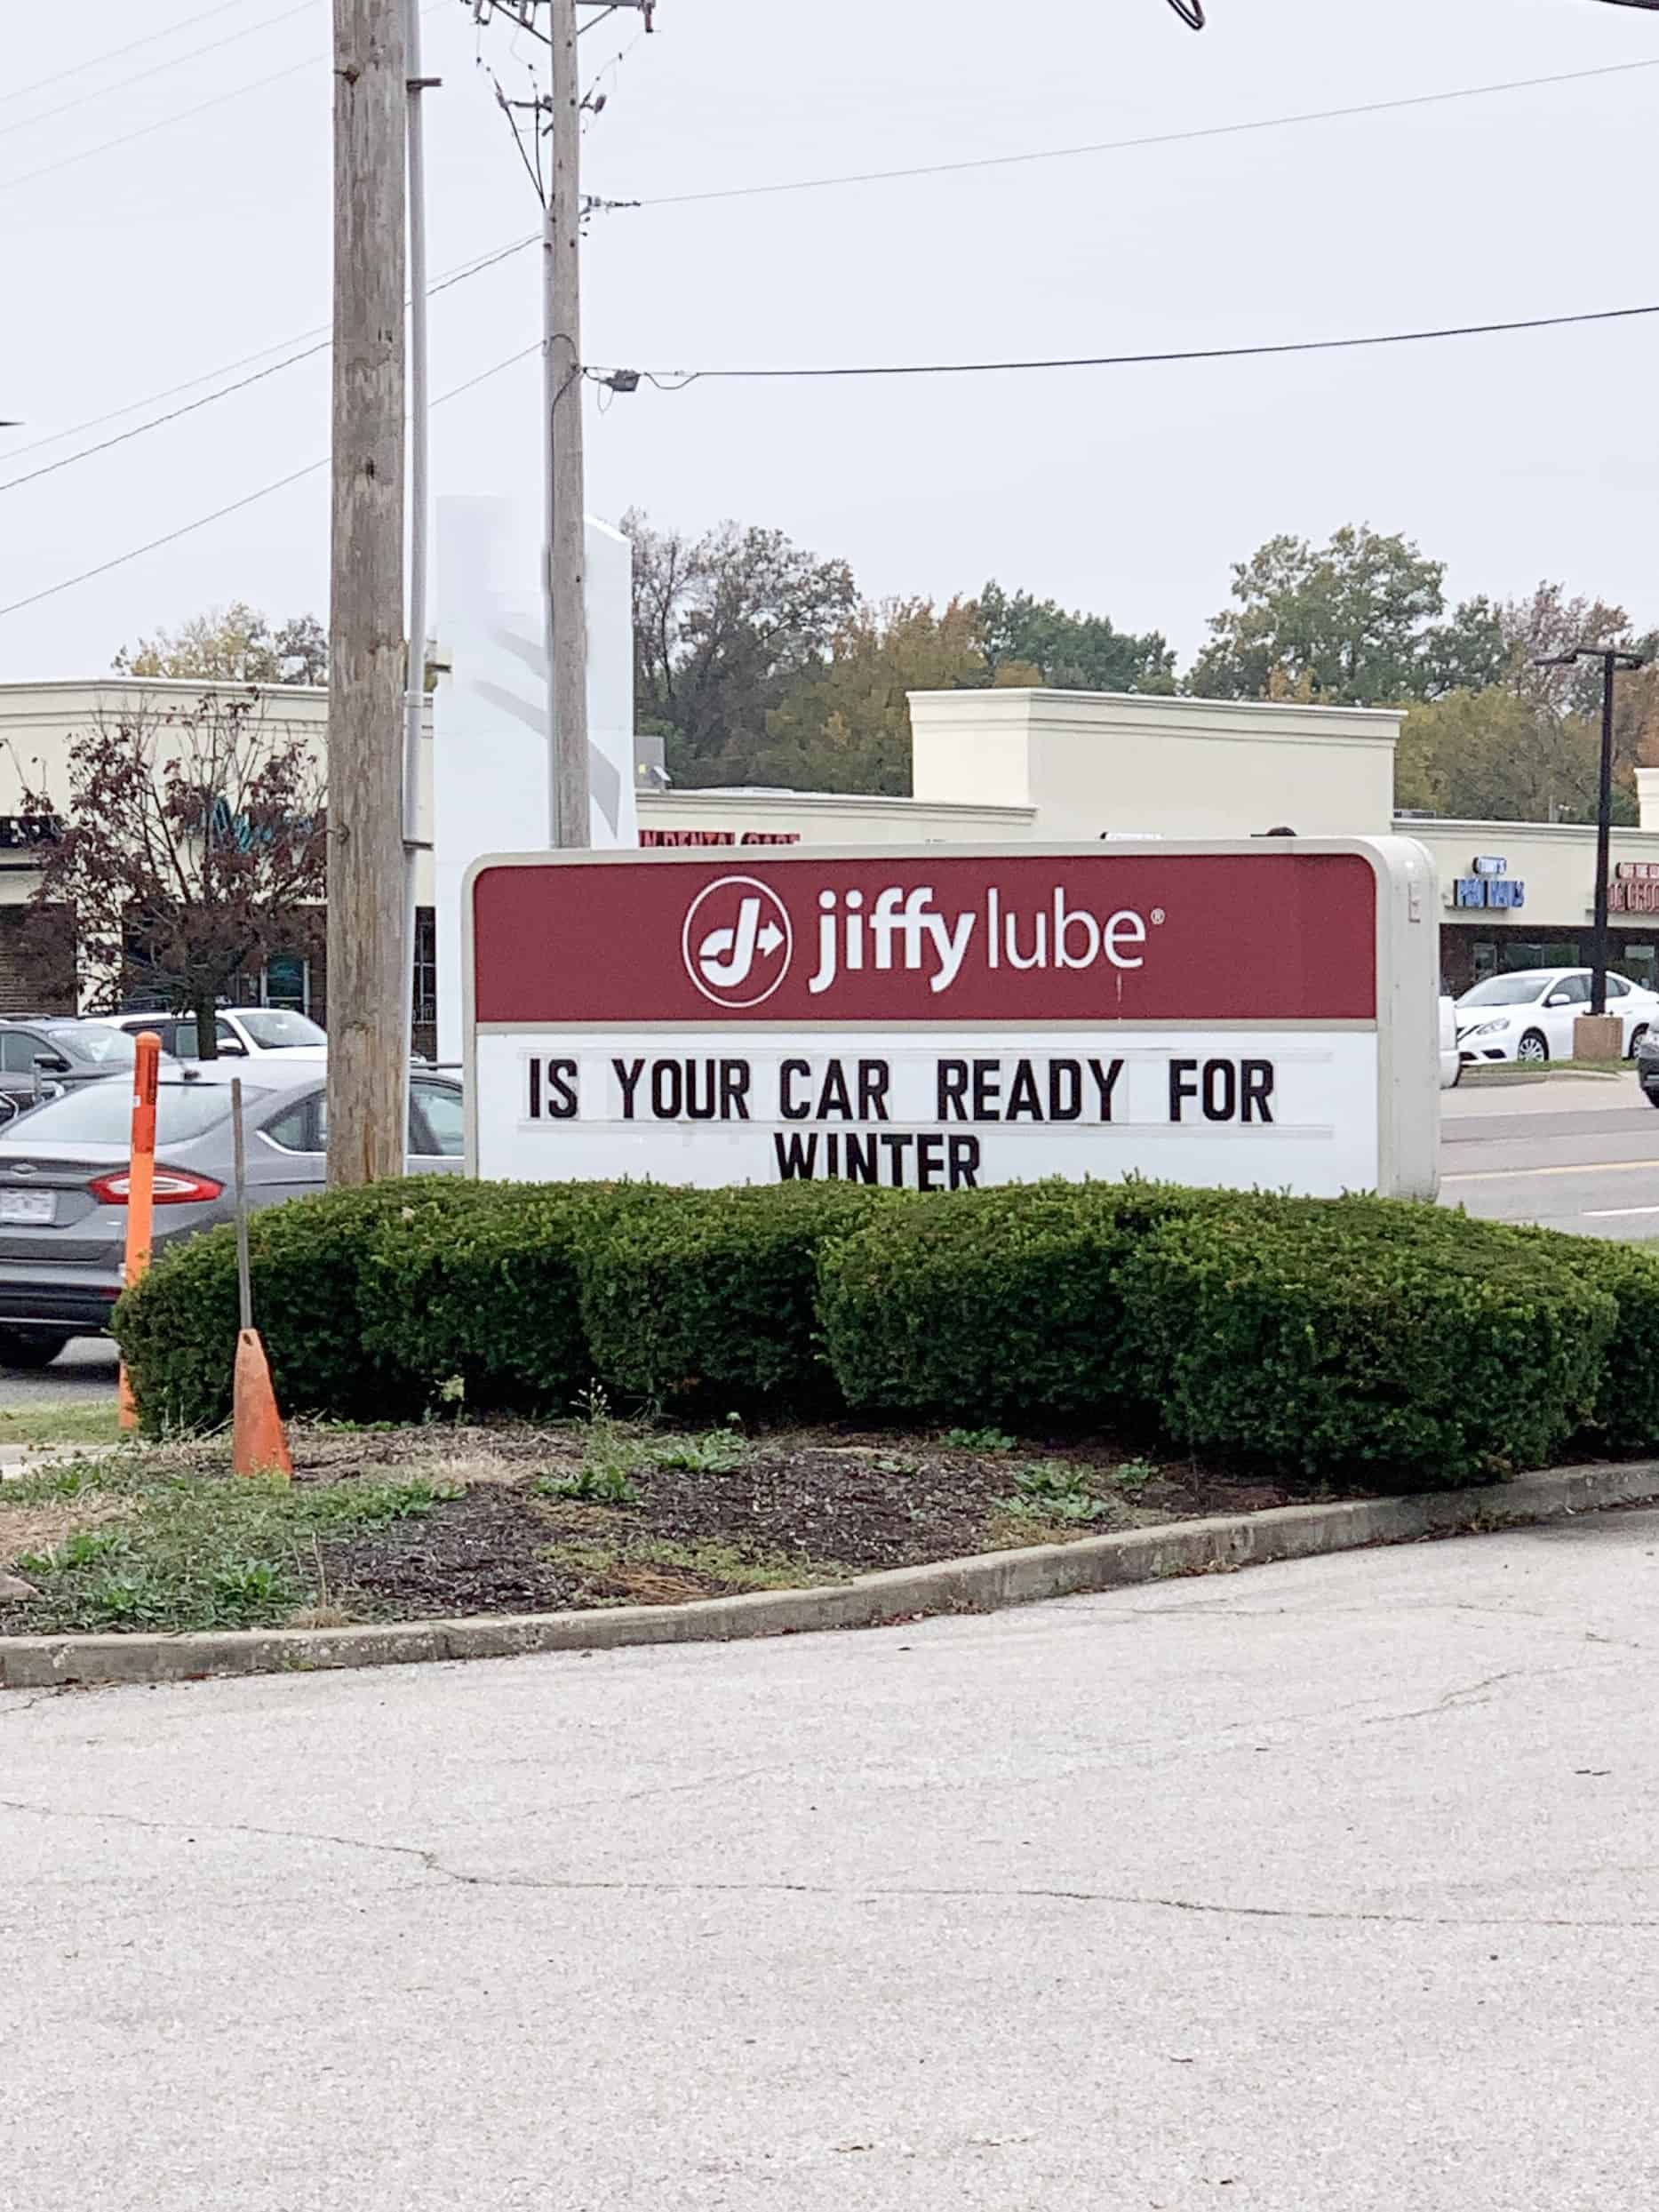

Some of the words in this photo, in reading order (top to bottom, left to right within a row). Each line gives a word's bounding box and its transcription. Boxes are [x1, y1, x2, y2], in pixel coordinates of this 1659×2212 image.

[810, 888, 975, 994] jiffy
[530, 1058, 578, 1119] IS
[611, 1058, 750, 1120] YOUR
[779, 1058, 889, 1121] CAR
[937, 1058, 1124, 1122] READY
[1168, 1058, 1274, 1122] FOR
[773, 1132, 981, 1193] WINTER
